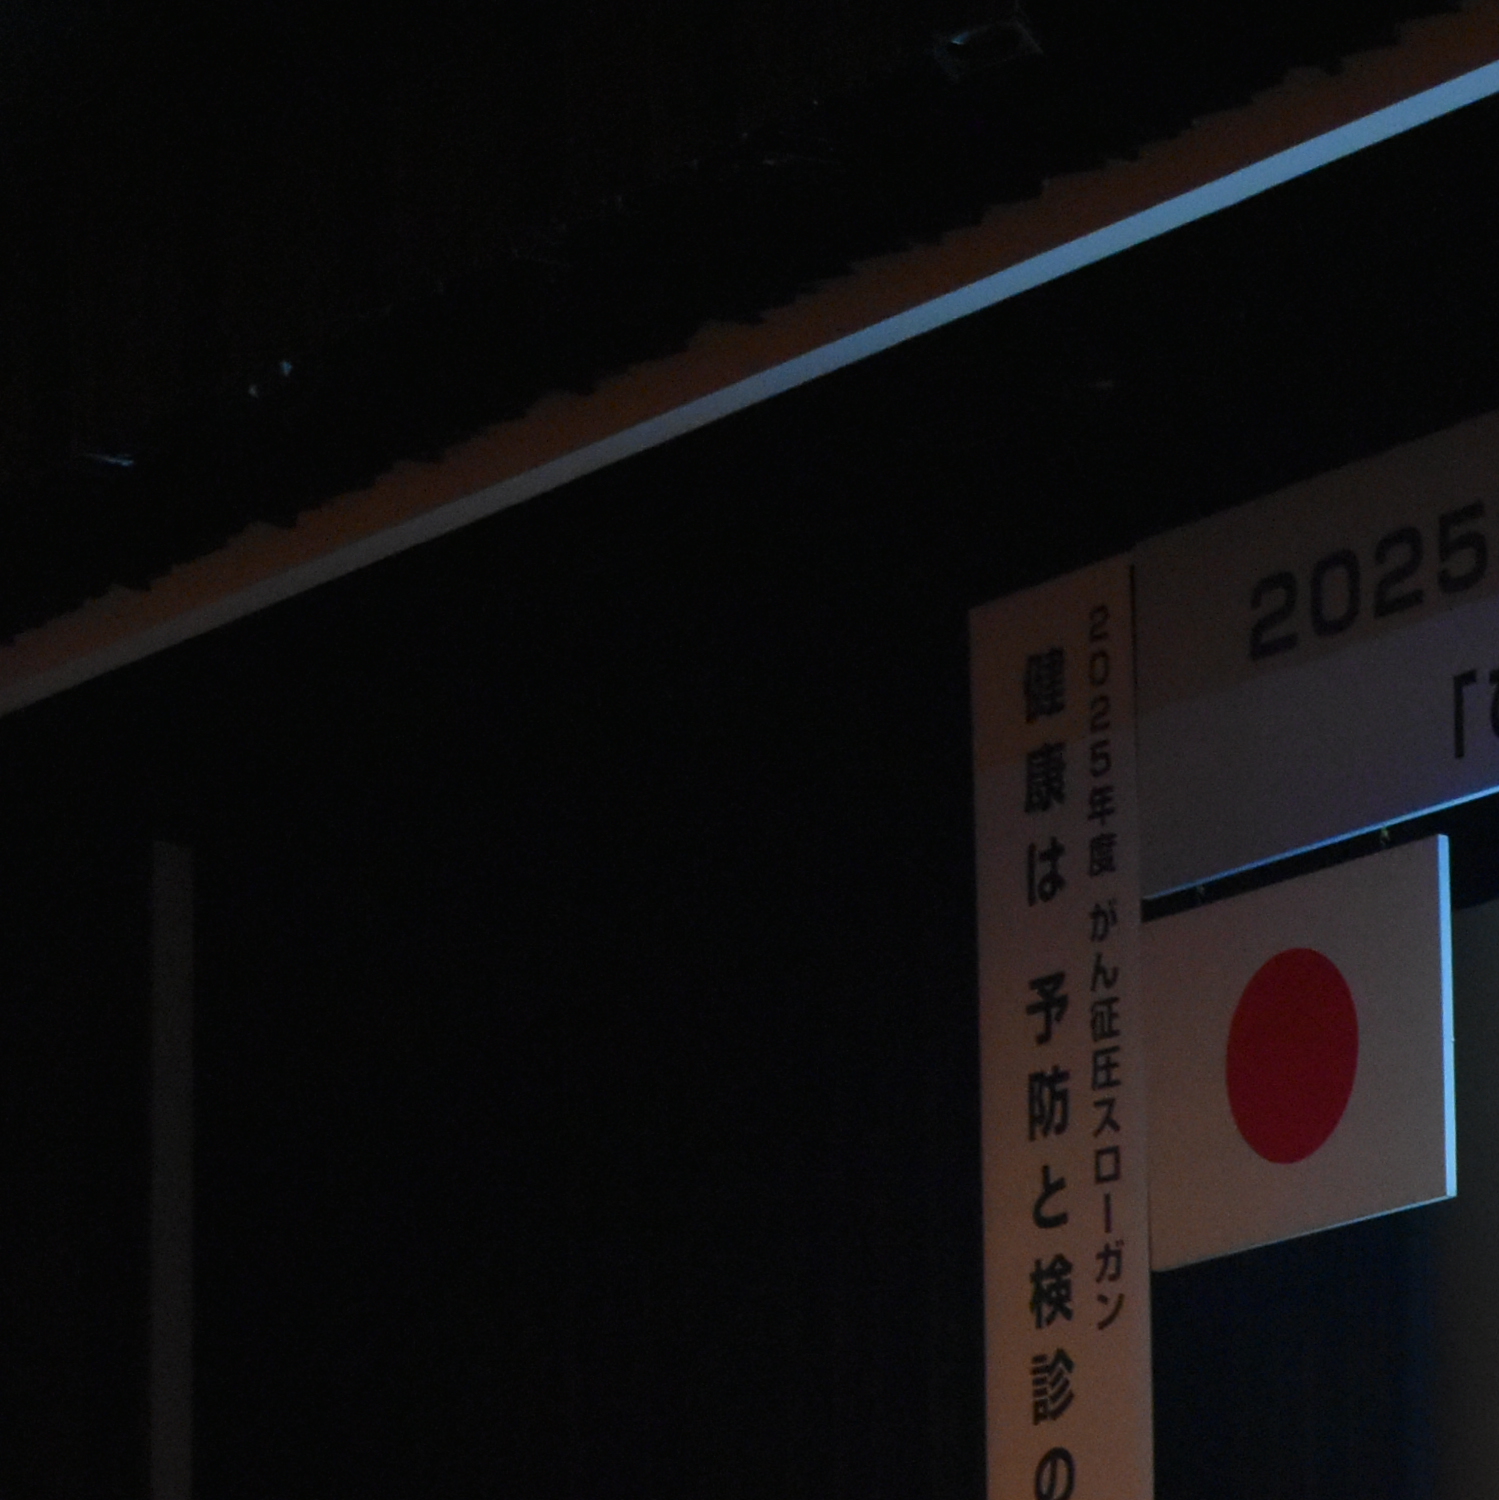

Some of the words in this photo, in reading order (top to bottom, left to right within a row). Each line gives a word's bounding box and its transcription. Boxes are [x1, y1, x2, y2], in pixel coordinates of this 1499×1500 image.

[1024, 647, 1066, 907] 健康は
[1088, 604, 1118, 877] 2025年度
[1089, 900, 1125, 1331] がん征圧スローガン
